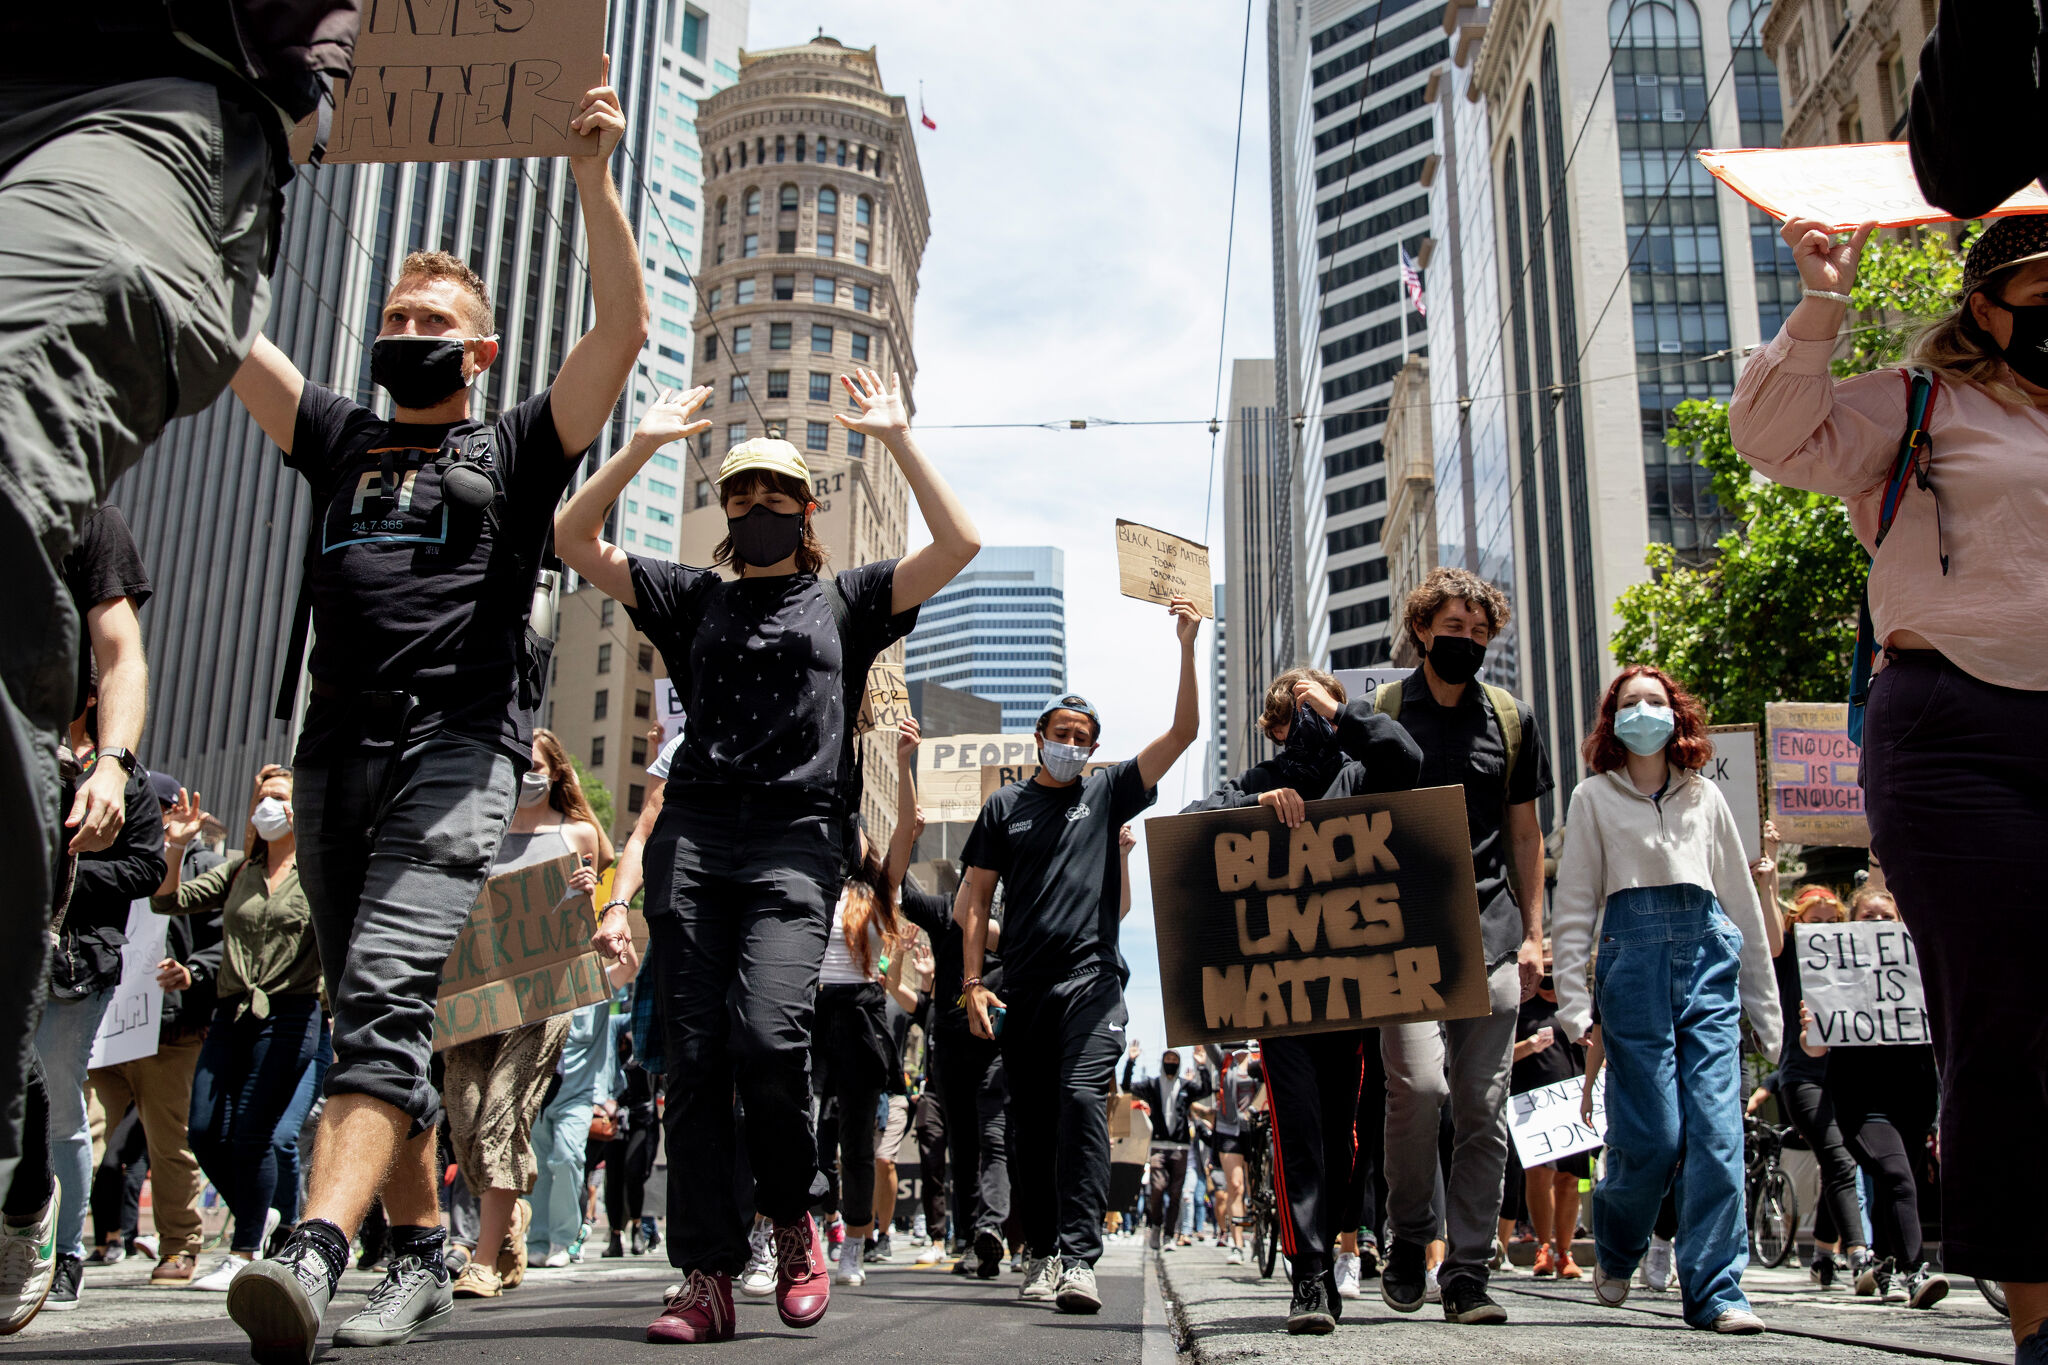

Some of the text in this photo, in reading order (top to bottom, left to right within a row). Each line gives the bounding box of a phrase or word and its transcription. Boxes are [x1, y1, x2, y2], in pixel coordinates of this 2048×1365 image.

[352, 520, 403, 532] 24.7.365
[1118, 525, 1209, 568] BLACK LIVES MATTER
[1150, 567, 1187, 586] TOMORROW
[1152, 556, 1176, 572] TODAY
[870, 688, 908, 704] FOR
[1780, 735, 1859, 758] ENOUGH
[1811, 765, 1828, 784] IS
[1783, 788, 1860, 809] ENOUGH
[1215, 810, 1400, 892] BLACK
[1235, 883, 1405, 956] LIVES
[441, 903, 591, 986] ACK LIVES
[514, 954, 605, 1024] POLICE
[1202, 945, 1447, 1029] MATTER
[1873, 969, 1907, 1002] IS
